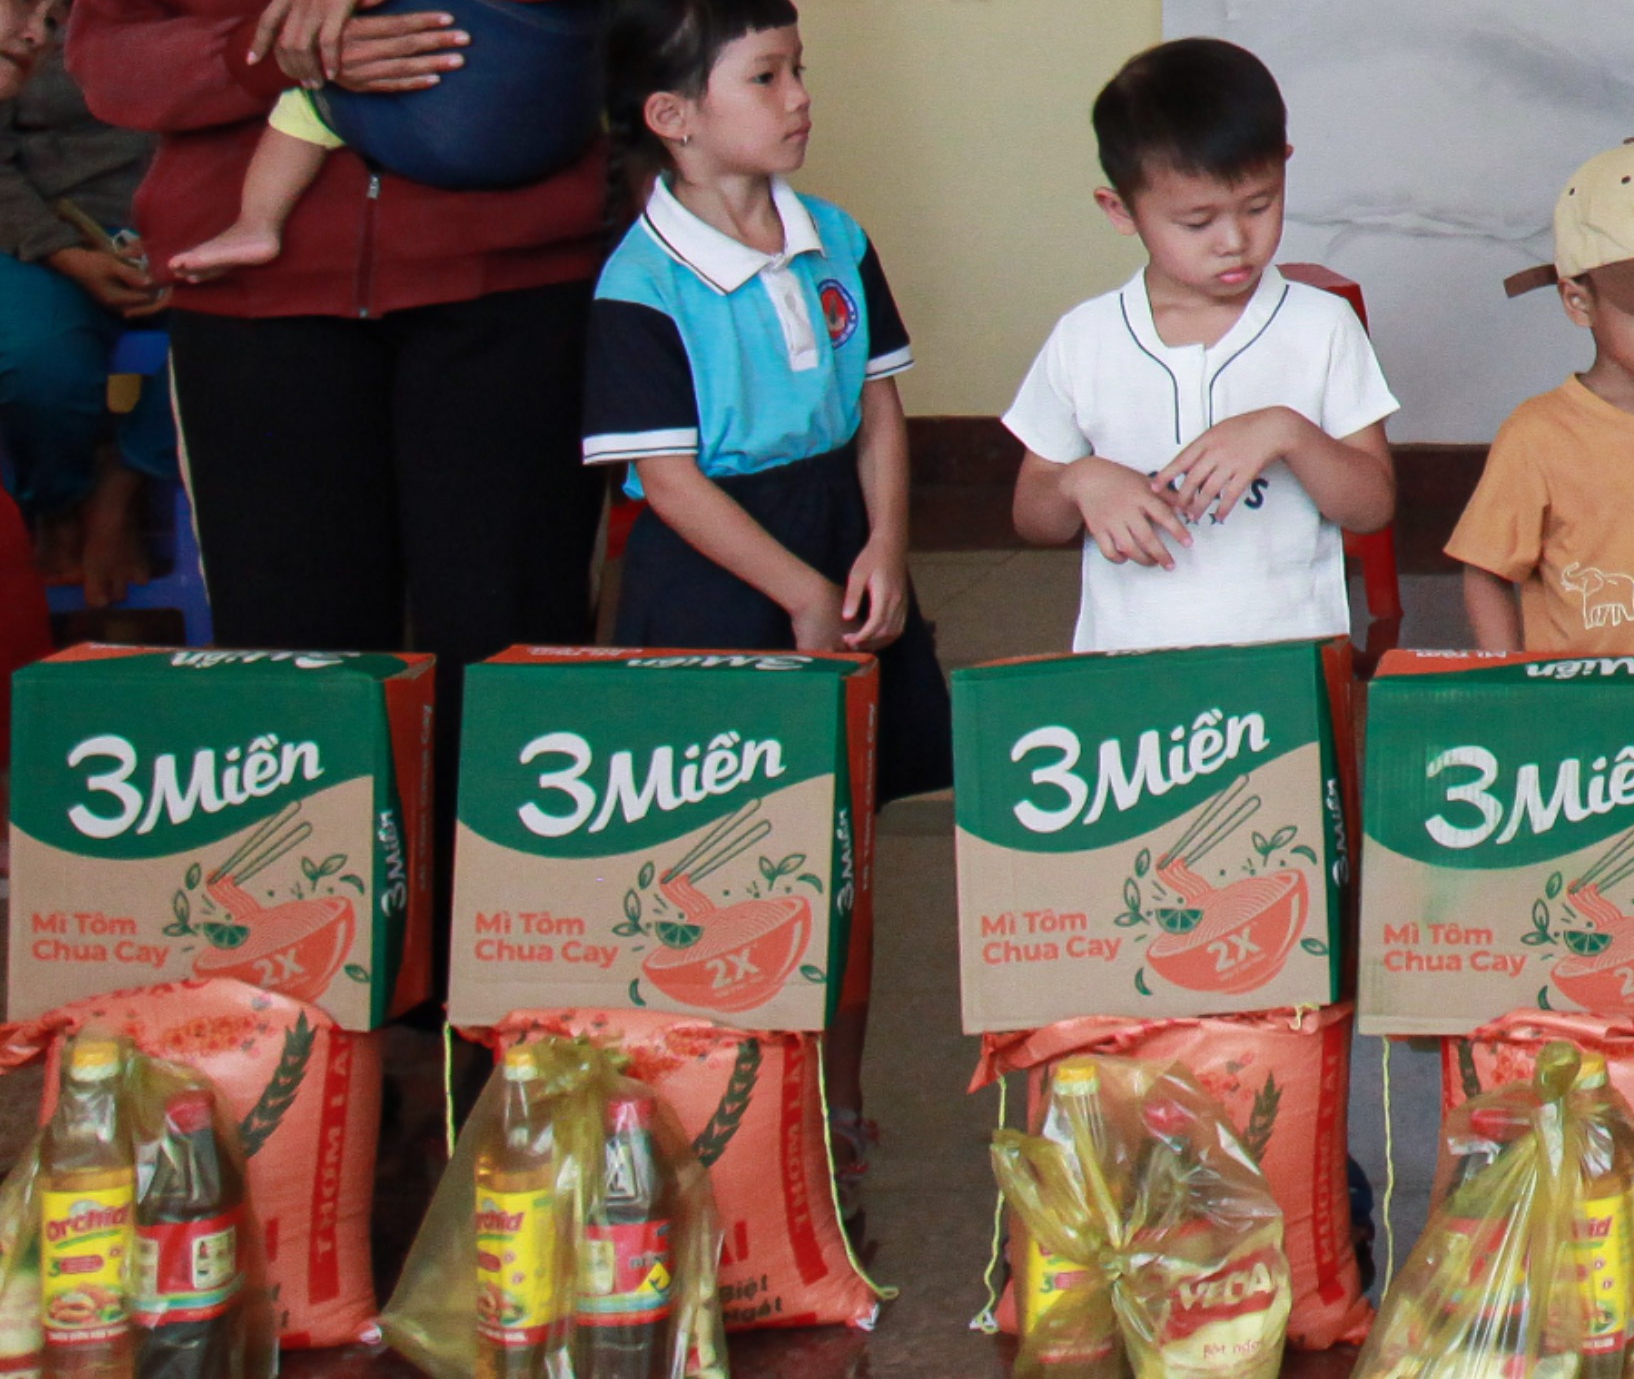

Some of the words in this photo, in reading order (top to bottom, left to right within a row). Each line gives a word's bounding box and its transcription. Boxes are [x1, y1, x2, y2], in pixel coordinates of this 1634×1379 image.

[68, 733, 326, 841] 3Miền
[519, 730, 789, 840] 3Miền
[1011, 708, 1273, 837] 3Miền
[32, 913, 67, 941] Mì
[73, 912, 137, 935] Tôm
[475, 911, 511, 940] Mì
[518, 911, 585, 935] Tôm
[981, 912, 1016, 938] Mì
[1022, 909, 1087, 937] Tôm
[1384, 922, 1419, 945] Mì
[1427, 921, 1493, 945] Tôm
[32, 939, 108, 962] Chua
[113, 935, 173, 969] Cay
[474, 939, 554, 962] Chua
[561, 940, 619, 969] Cay
[982, 934, 1059, 965] Chua
[1066, 936, 1121, 961] Cay
[1203, 934, 1261, 971] 2X
[1380, 950, 1462, 972] Chua
[1469, 950, 1526, 977] Cay
[254, 949, 304, 990] 2X
[701, 951, 759, 993] 2X
